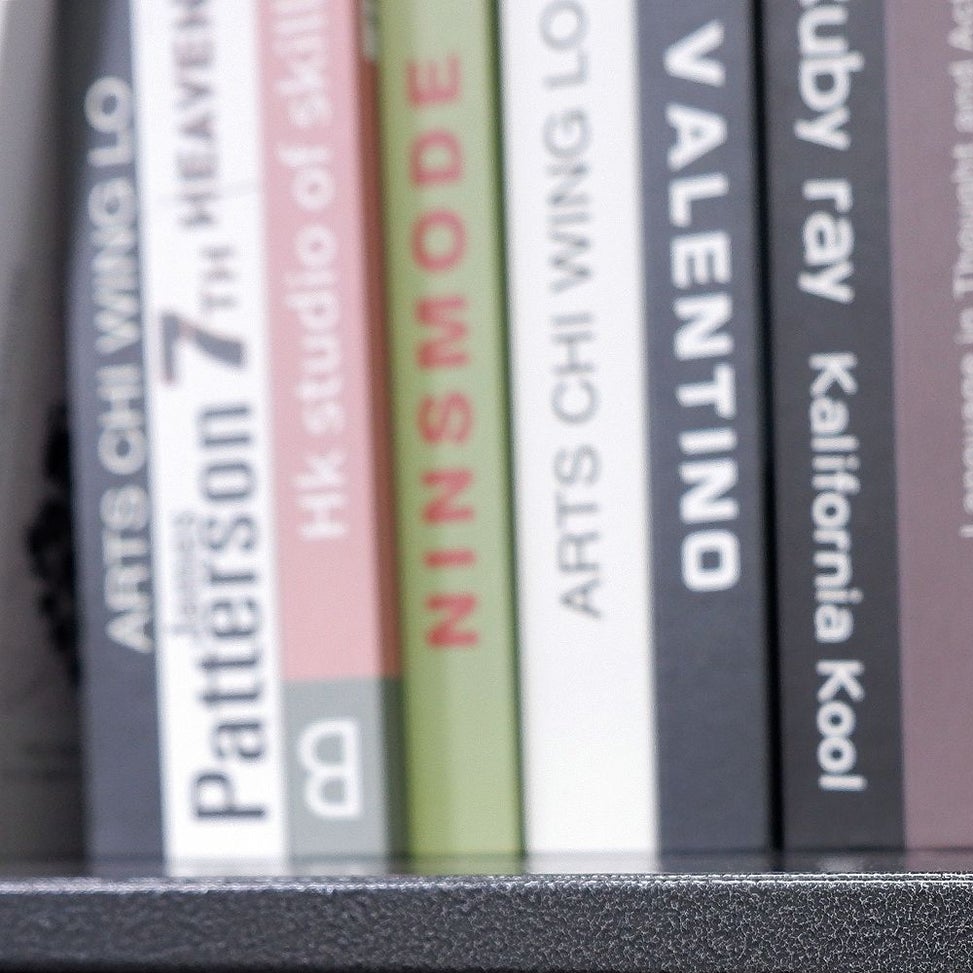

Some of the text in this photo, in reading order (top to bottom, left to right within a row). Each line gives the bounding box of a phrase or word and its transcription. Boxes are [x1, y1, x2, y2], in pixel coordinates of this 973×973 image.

[84, 75, 154, 653] ARTS CHI WING LO
[275, 144, 335, 212] of
[283, 224, 345, 438] studio
[539, 0, 604, 620] ARTS CHI WING LO
[664, 19, 741, 592] VALENTINO
[794, 0, 867, 791] uby ray Kalifornia Kool
[192, 405, 266, 821] Patterson
[294, 451, 349, 542] Hk
